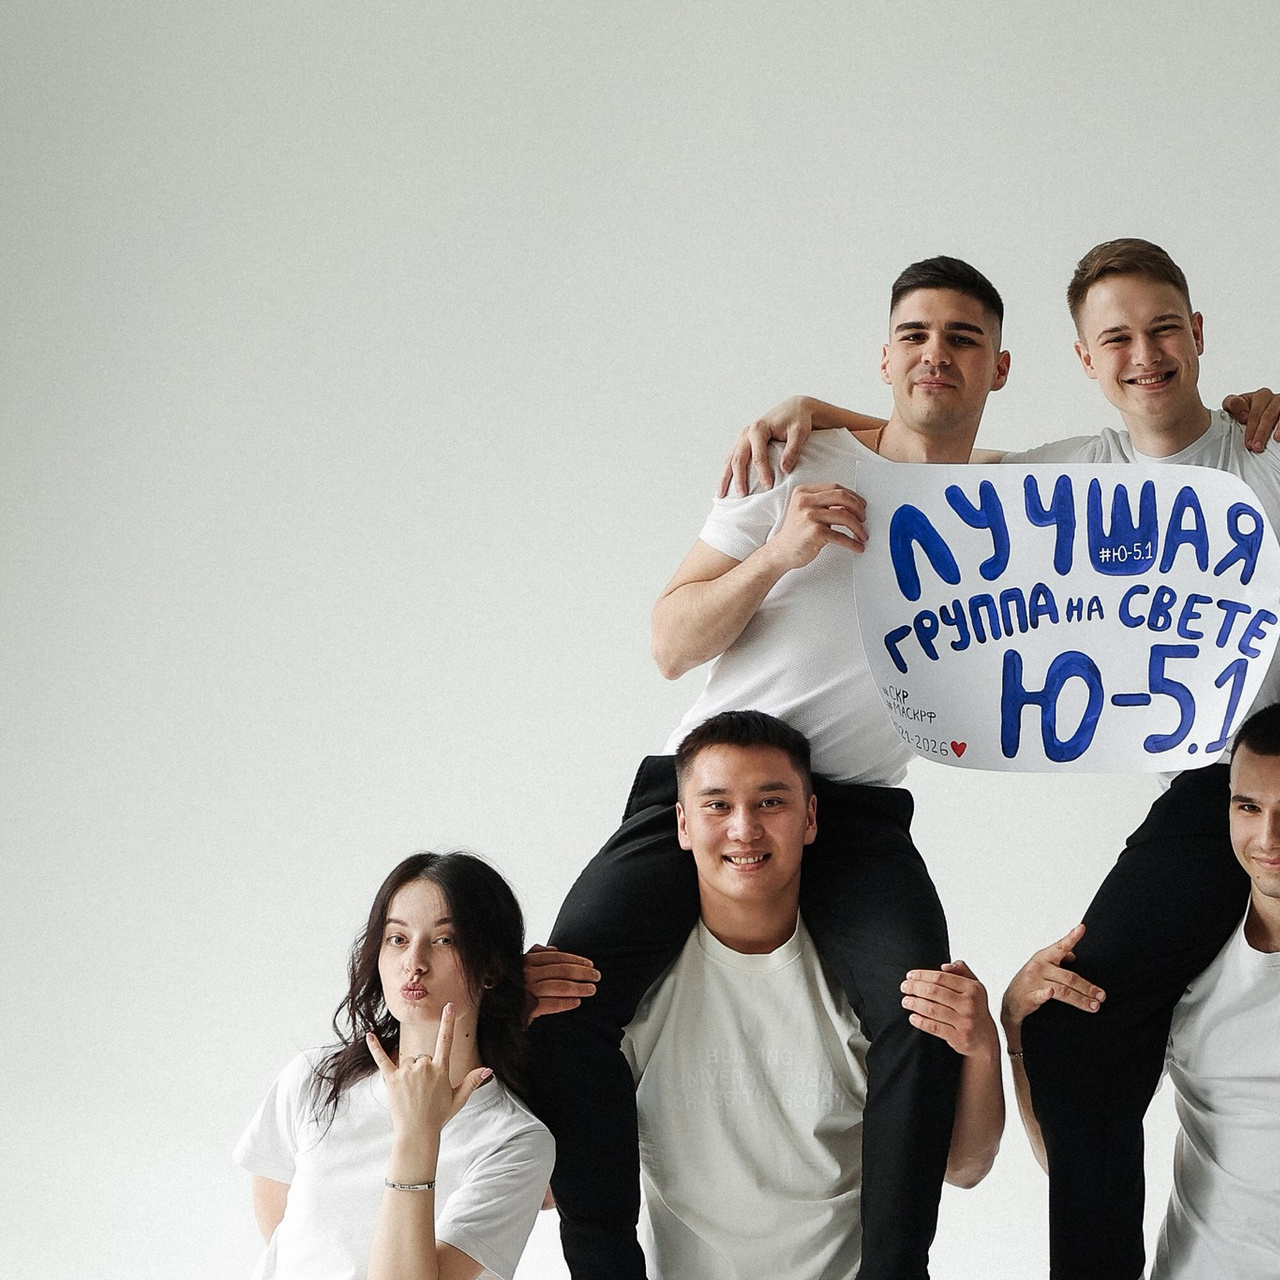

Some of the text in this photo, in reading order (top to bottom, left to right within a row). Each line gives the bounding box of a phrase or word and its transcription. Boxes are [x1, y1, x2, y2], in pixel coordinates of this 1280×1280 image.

[889, 474, 1265, 603] ЛУЧШАЯ
[1099, 541, 1153, 563] #Ю-5.1
[884, 582, 1279, 673] ГРУППА НА СВЕТЕ
[882, 685, 909, 705] #СКР
[1000, 643, 1249, 763] Ю-5.1
